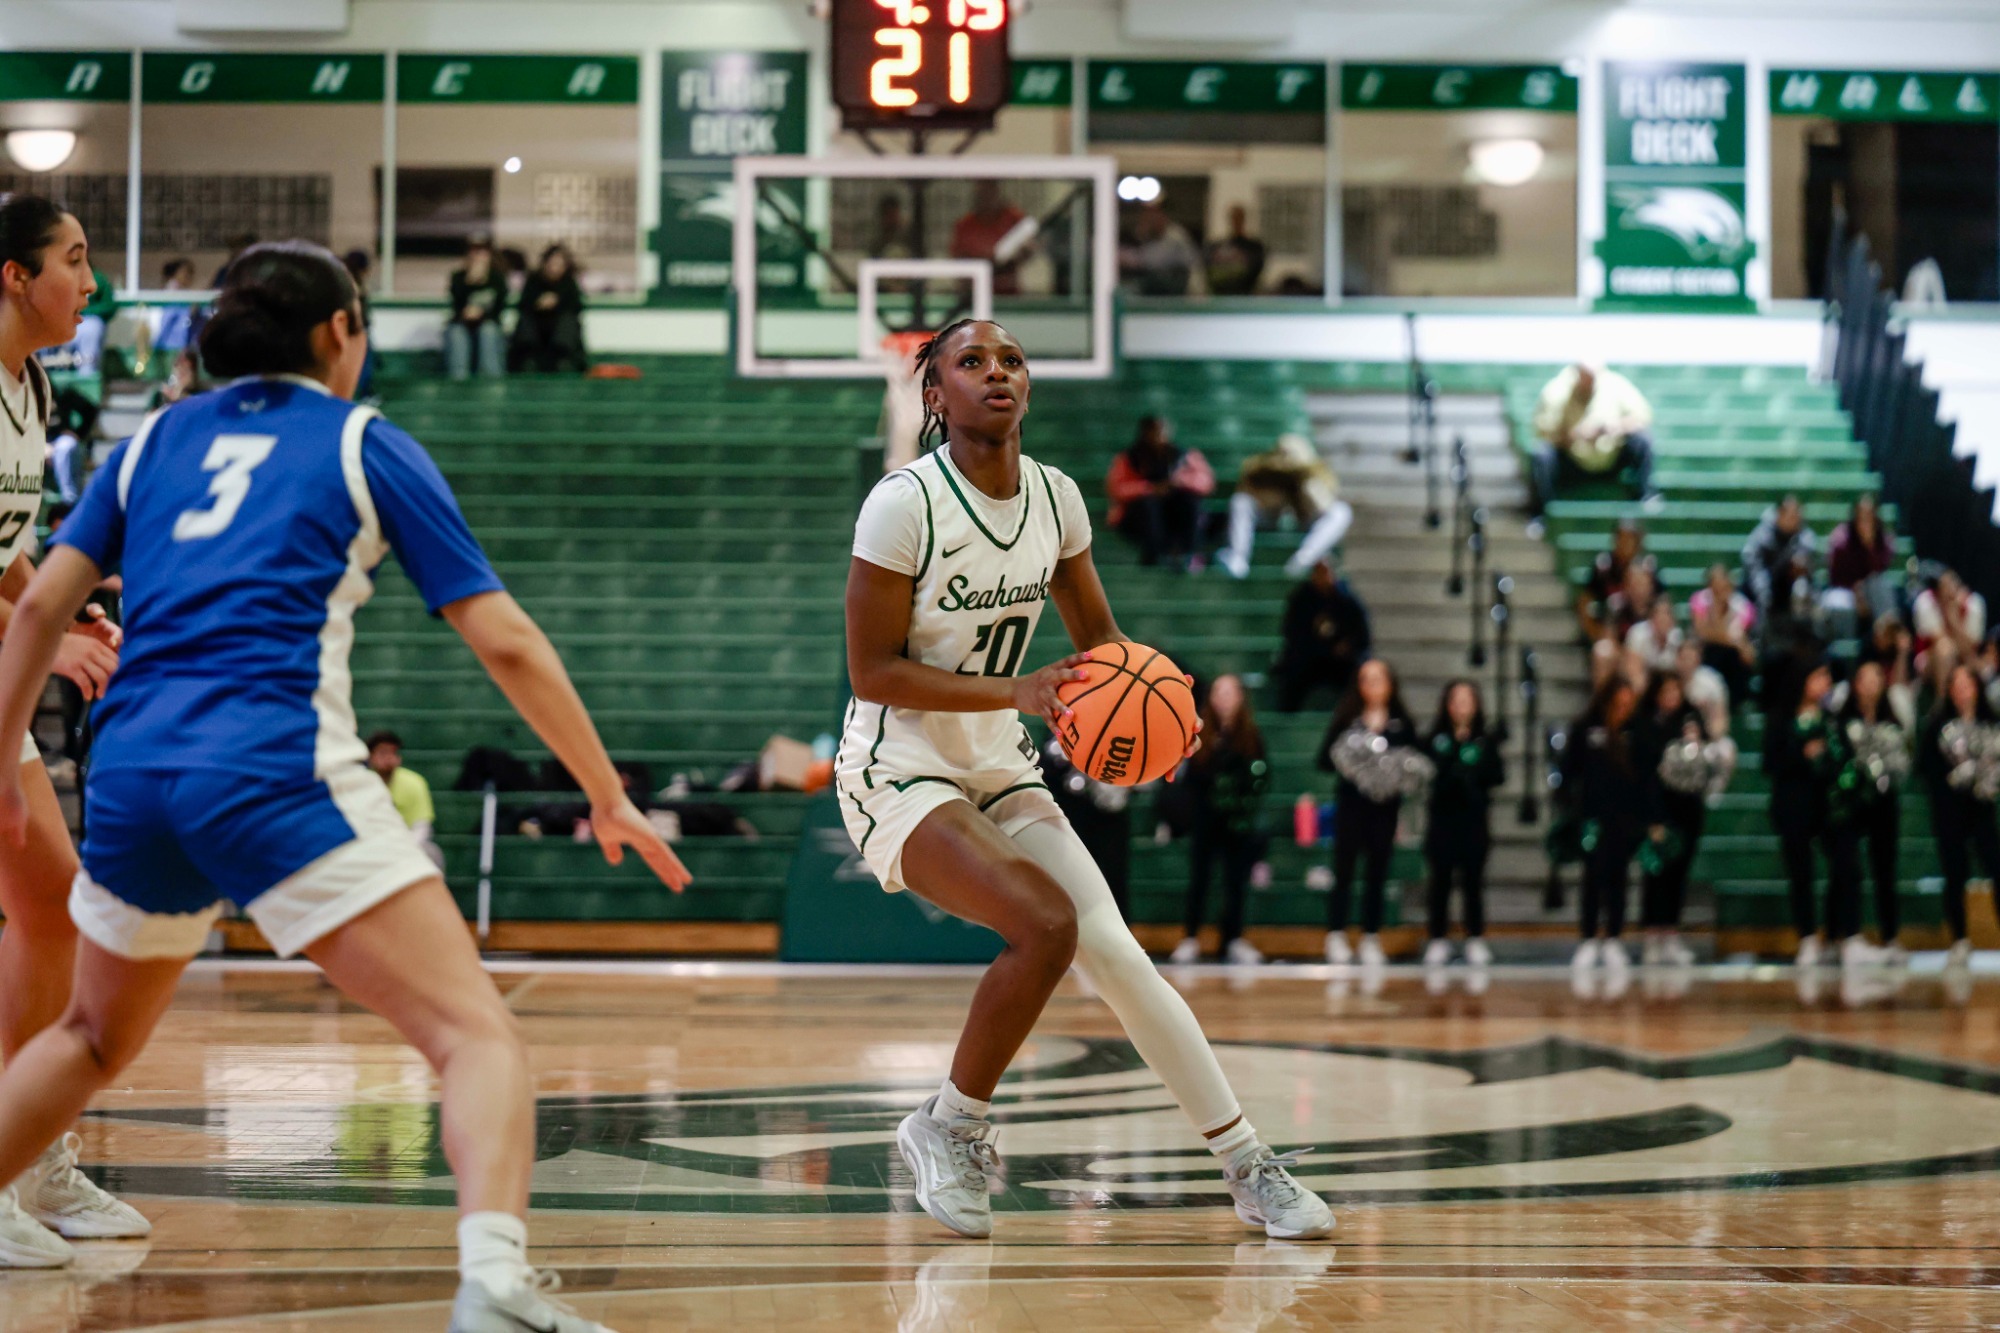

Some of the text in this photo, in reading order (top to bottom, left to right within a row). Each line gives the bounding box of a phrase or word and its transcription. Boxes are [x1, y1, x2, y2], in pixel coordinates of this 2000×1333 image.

[871, 27, 970, 107] 21
[678, 69, 791, 111] FLIGHT
[1619, 76, 1732, 120] FLIGHT
[690, 114, 778, 155] DECK
[1631, 120, 1720, 164] DECK
[172, 434, 279, 542] 3
